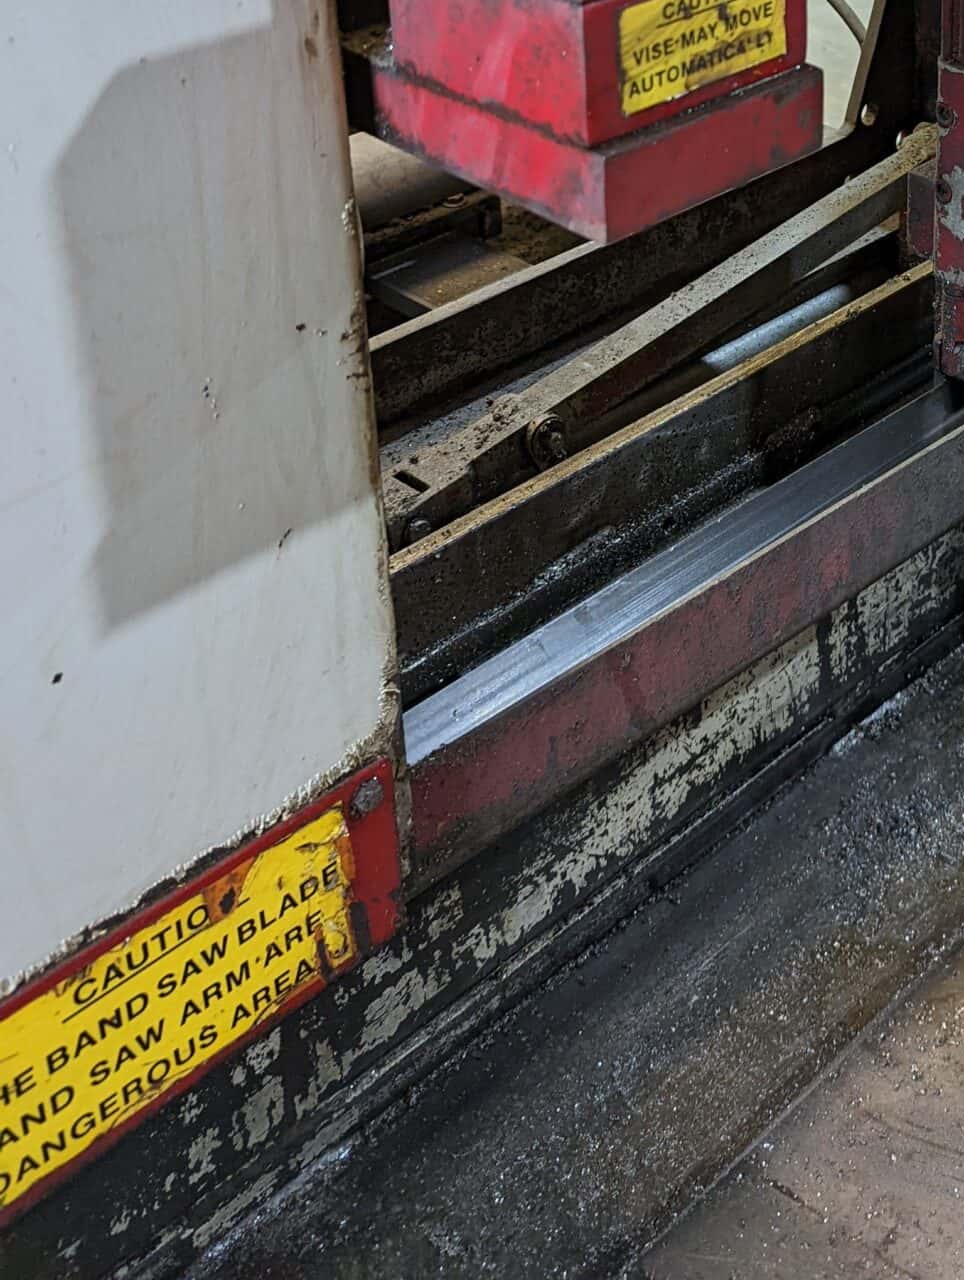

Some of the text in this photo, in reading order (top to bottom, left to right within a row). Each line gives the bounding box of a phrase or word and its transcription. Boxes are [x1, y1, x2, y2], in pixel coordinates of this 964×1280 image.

[725, 1, 774, 33] MOVE
[46, 991, 150, 1077] BAND
[157, 934, 230, 1000] SAW
[237, 860, 340, 948] BLADE
[72, 901, 211, 1008] CAUTIO
[231, 958, 316, 1029] AREA
[0, 908, 324, 1154] AND SAW ARM ARE
